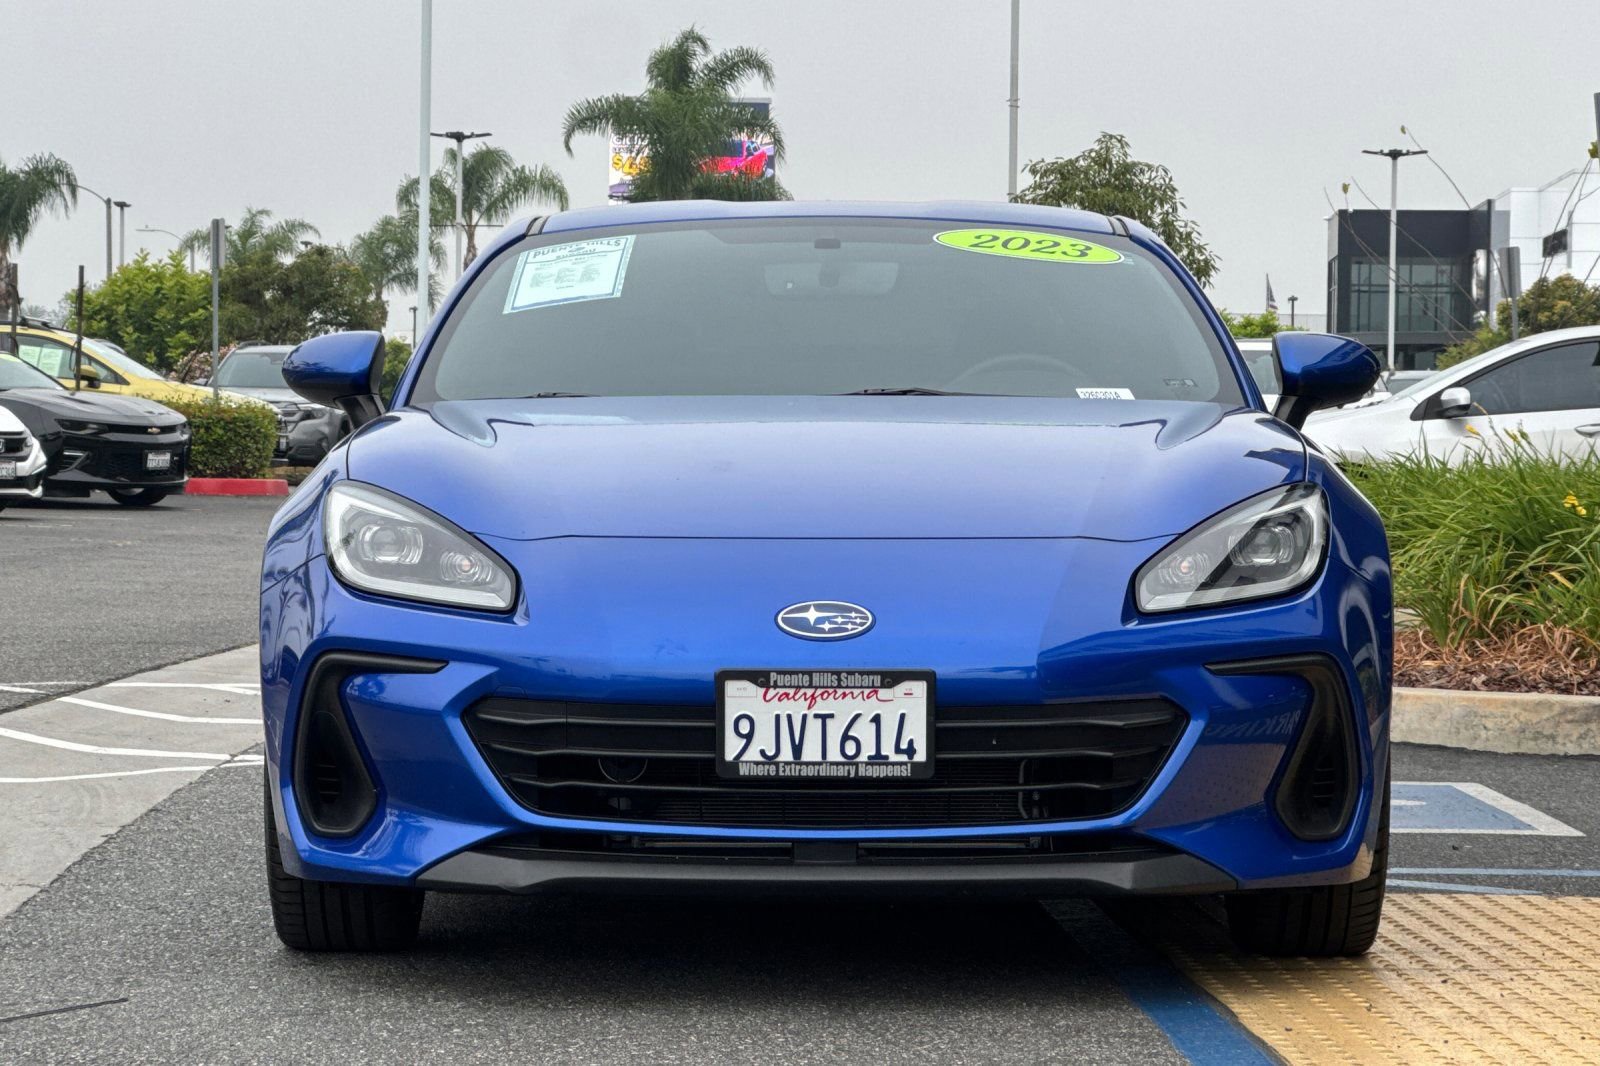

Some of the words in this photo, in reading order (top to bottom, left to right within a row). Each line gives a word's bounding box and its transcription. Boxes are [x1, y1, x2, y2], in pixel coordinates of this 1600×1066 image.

[968, 233, 1093, 258] 2023
[769, 672, 809, 687] Puente
[812, 672, 838, 687] Hills
[840, 672, 881, 687] Subaru
[762, 687, 894, 710] California
[732, 712, 917, 761] 9JVT614
[739, 763, 776, 776] Where
[778, 763, 856, 778] Extraordinary
[858, 763, 911, 777] Happens!
